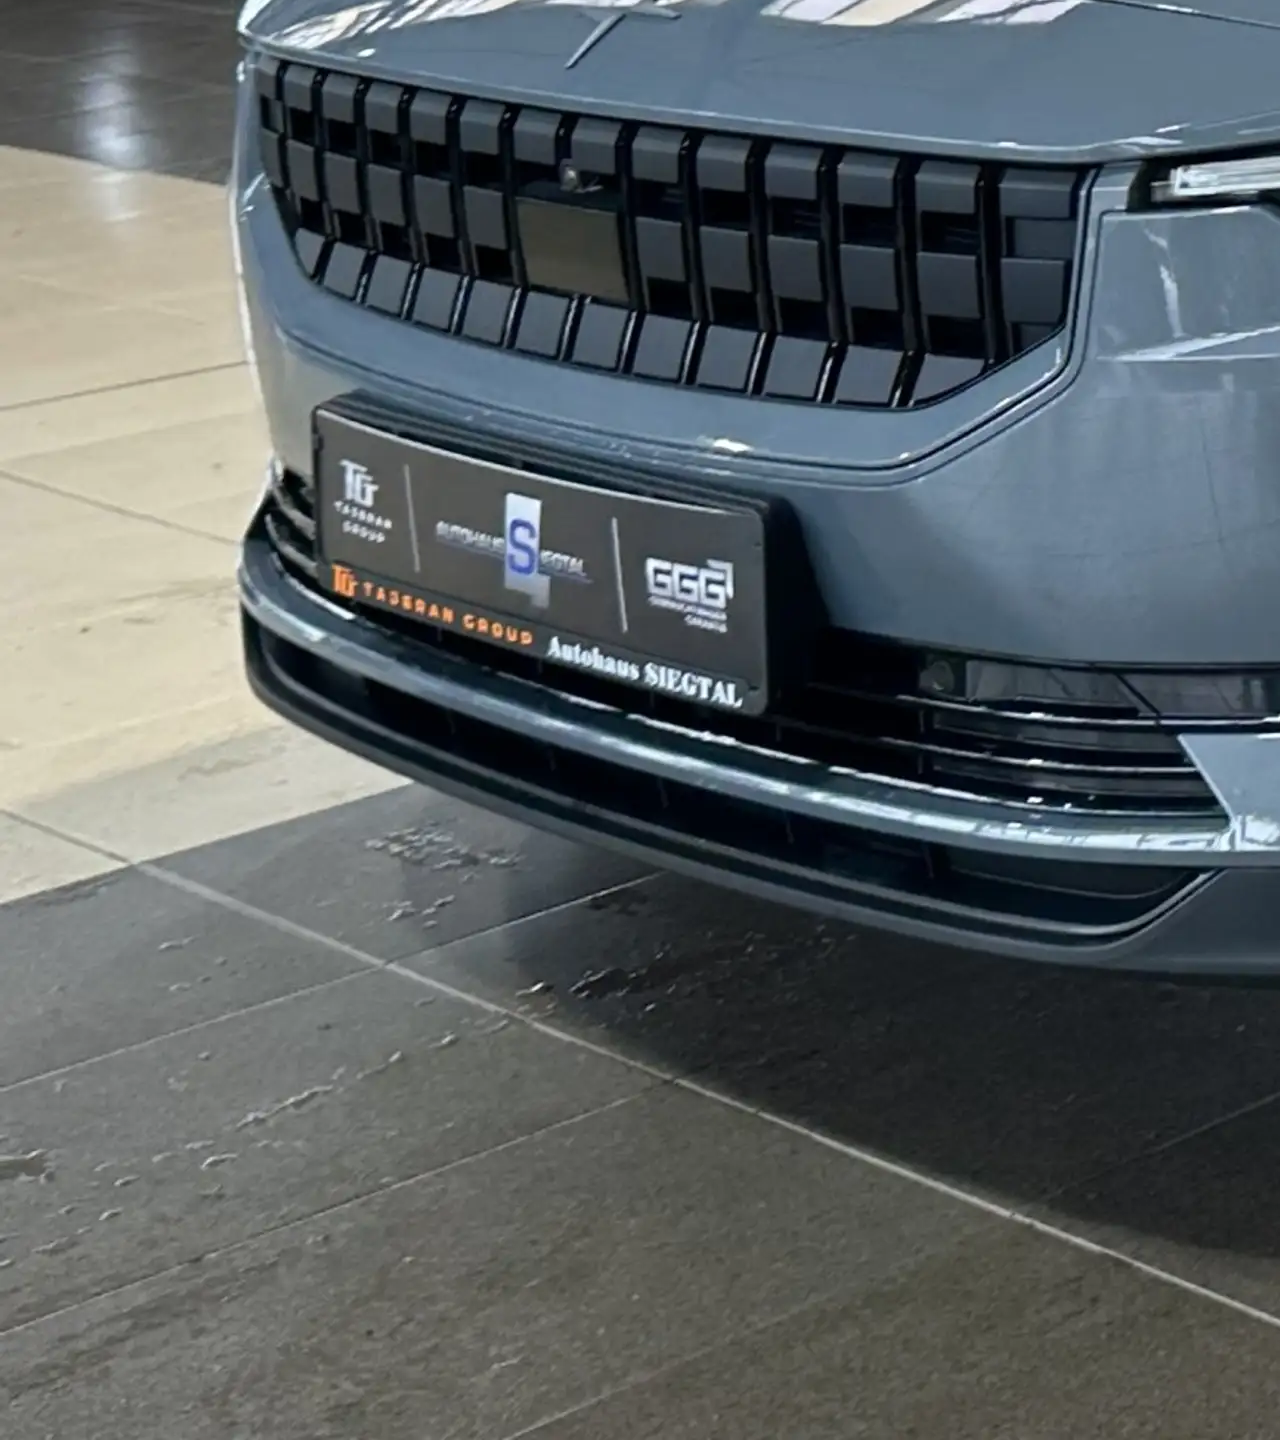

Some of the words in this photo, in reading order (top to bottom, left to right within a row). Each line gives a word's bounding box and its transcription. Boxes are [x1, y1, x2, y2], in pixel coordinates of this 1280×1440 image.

[462, 612, 534, 646] GROUP
[546, 635, 640, 681] Autohaus
[643, 661, 744, 709] SIEGTAL
